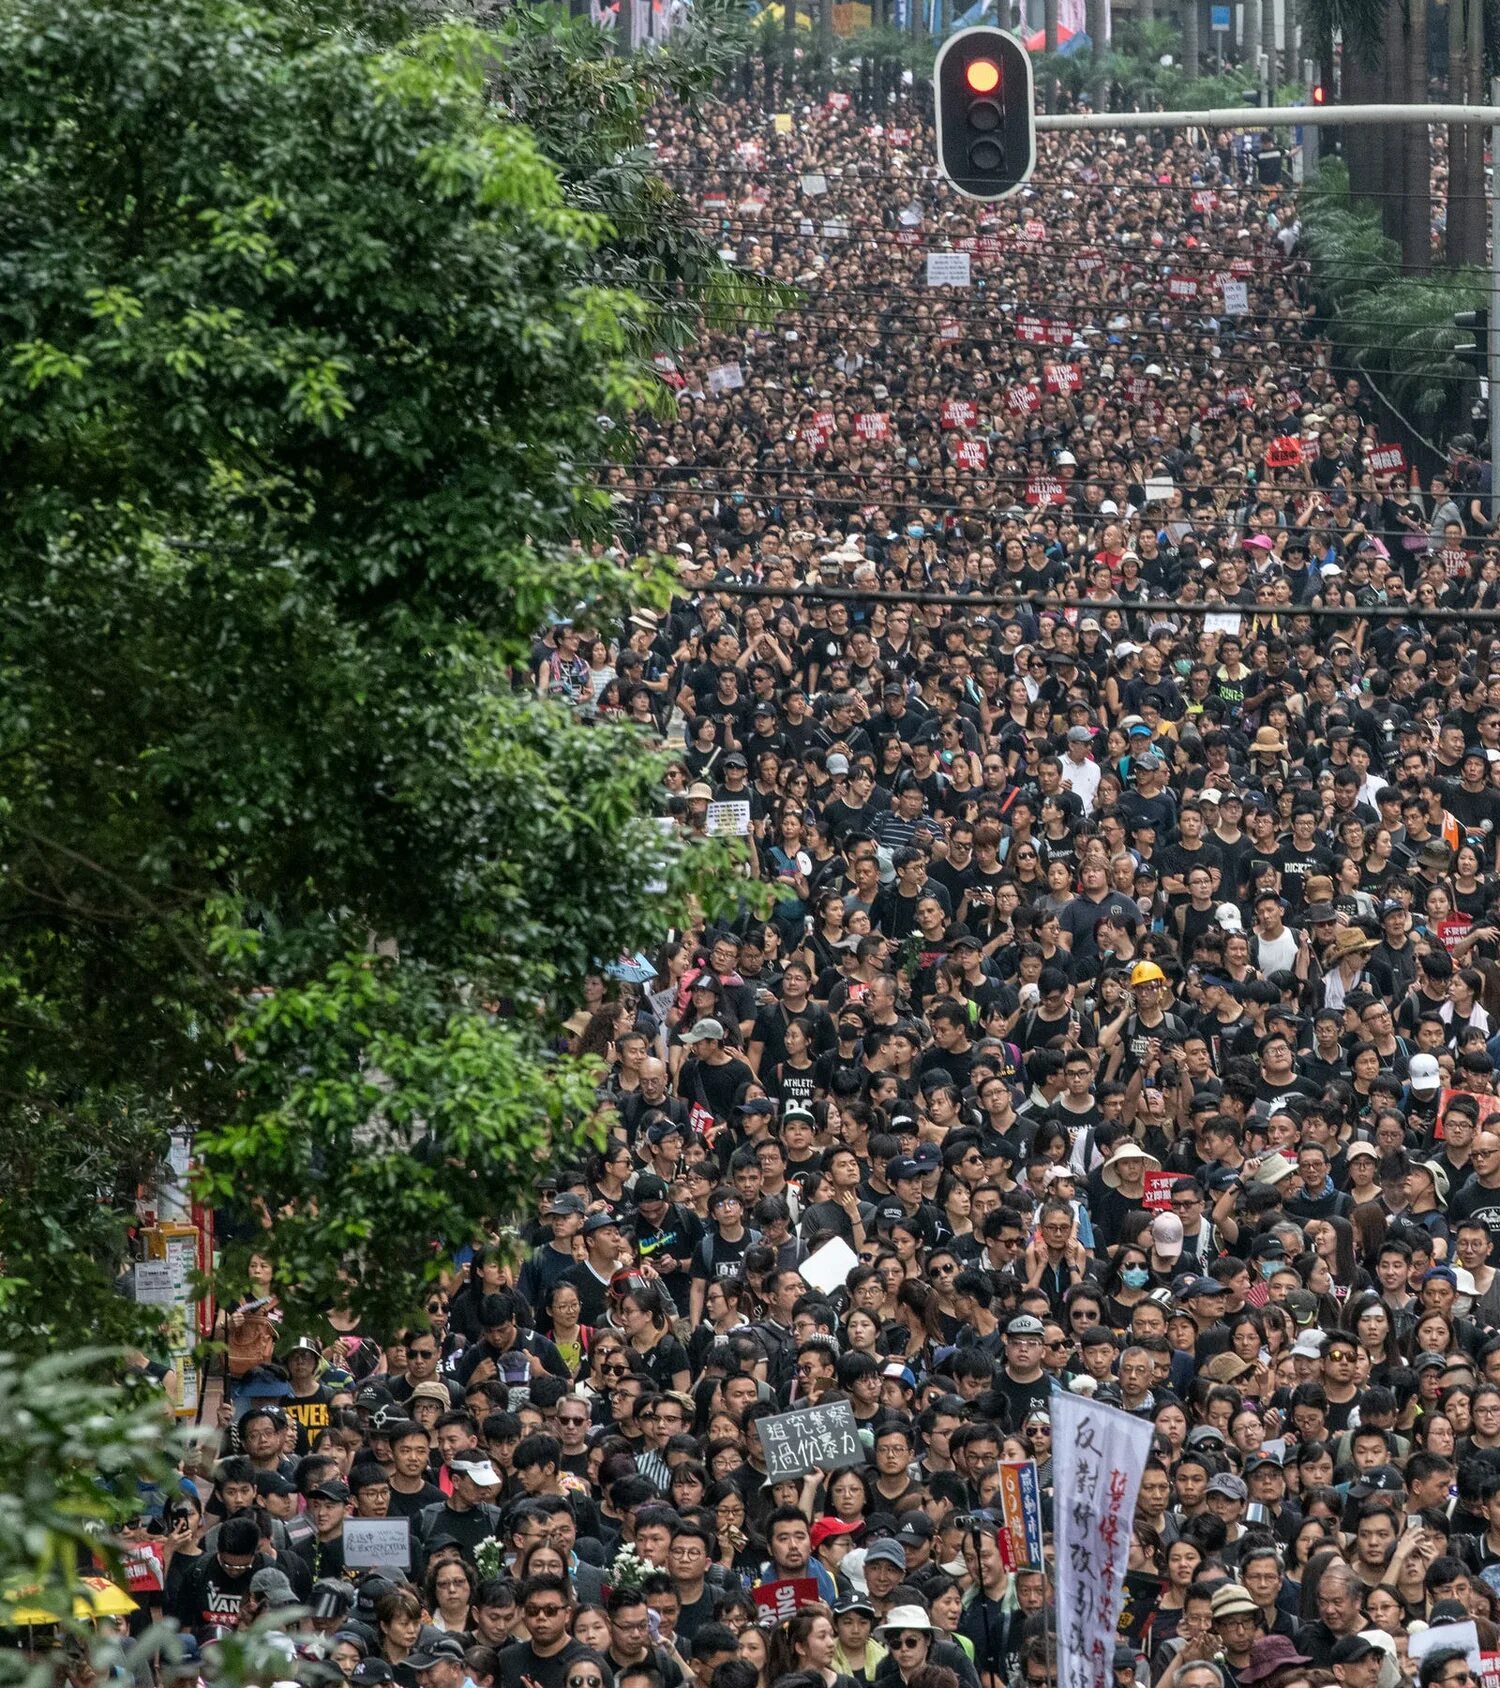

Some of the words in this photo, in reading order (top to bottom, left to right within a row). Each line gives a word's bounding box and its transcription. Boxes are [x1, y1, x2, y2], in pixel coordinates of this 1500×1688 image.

[1052, 365, 1072, 374] STOP
[1047, 373, 1078, 384] KILLING
[949, 402, 969, 411] STOP
[861, 414, 880, 422] STOP
[944, 410, 975, 420] KILLING
[856, 422, 886, 431] KILLING
[964, 443, 980, 451] STOP
[959, 449, 984, 461] KILLING
[1029, 485, 1062, 494] KILLING
[1442, 550, 1466, 560] STOP
[791, 1088, 810, 1097] TEAM
[766, 1406, 850, 1441] 追究警察
[770, 1431, 856, 1477] 過份暴力
[207, 1592, 242, 1614] VAN
